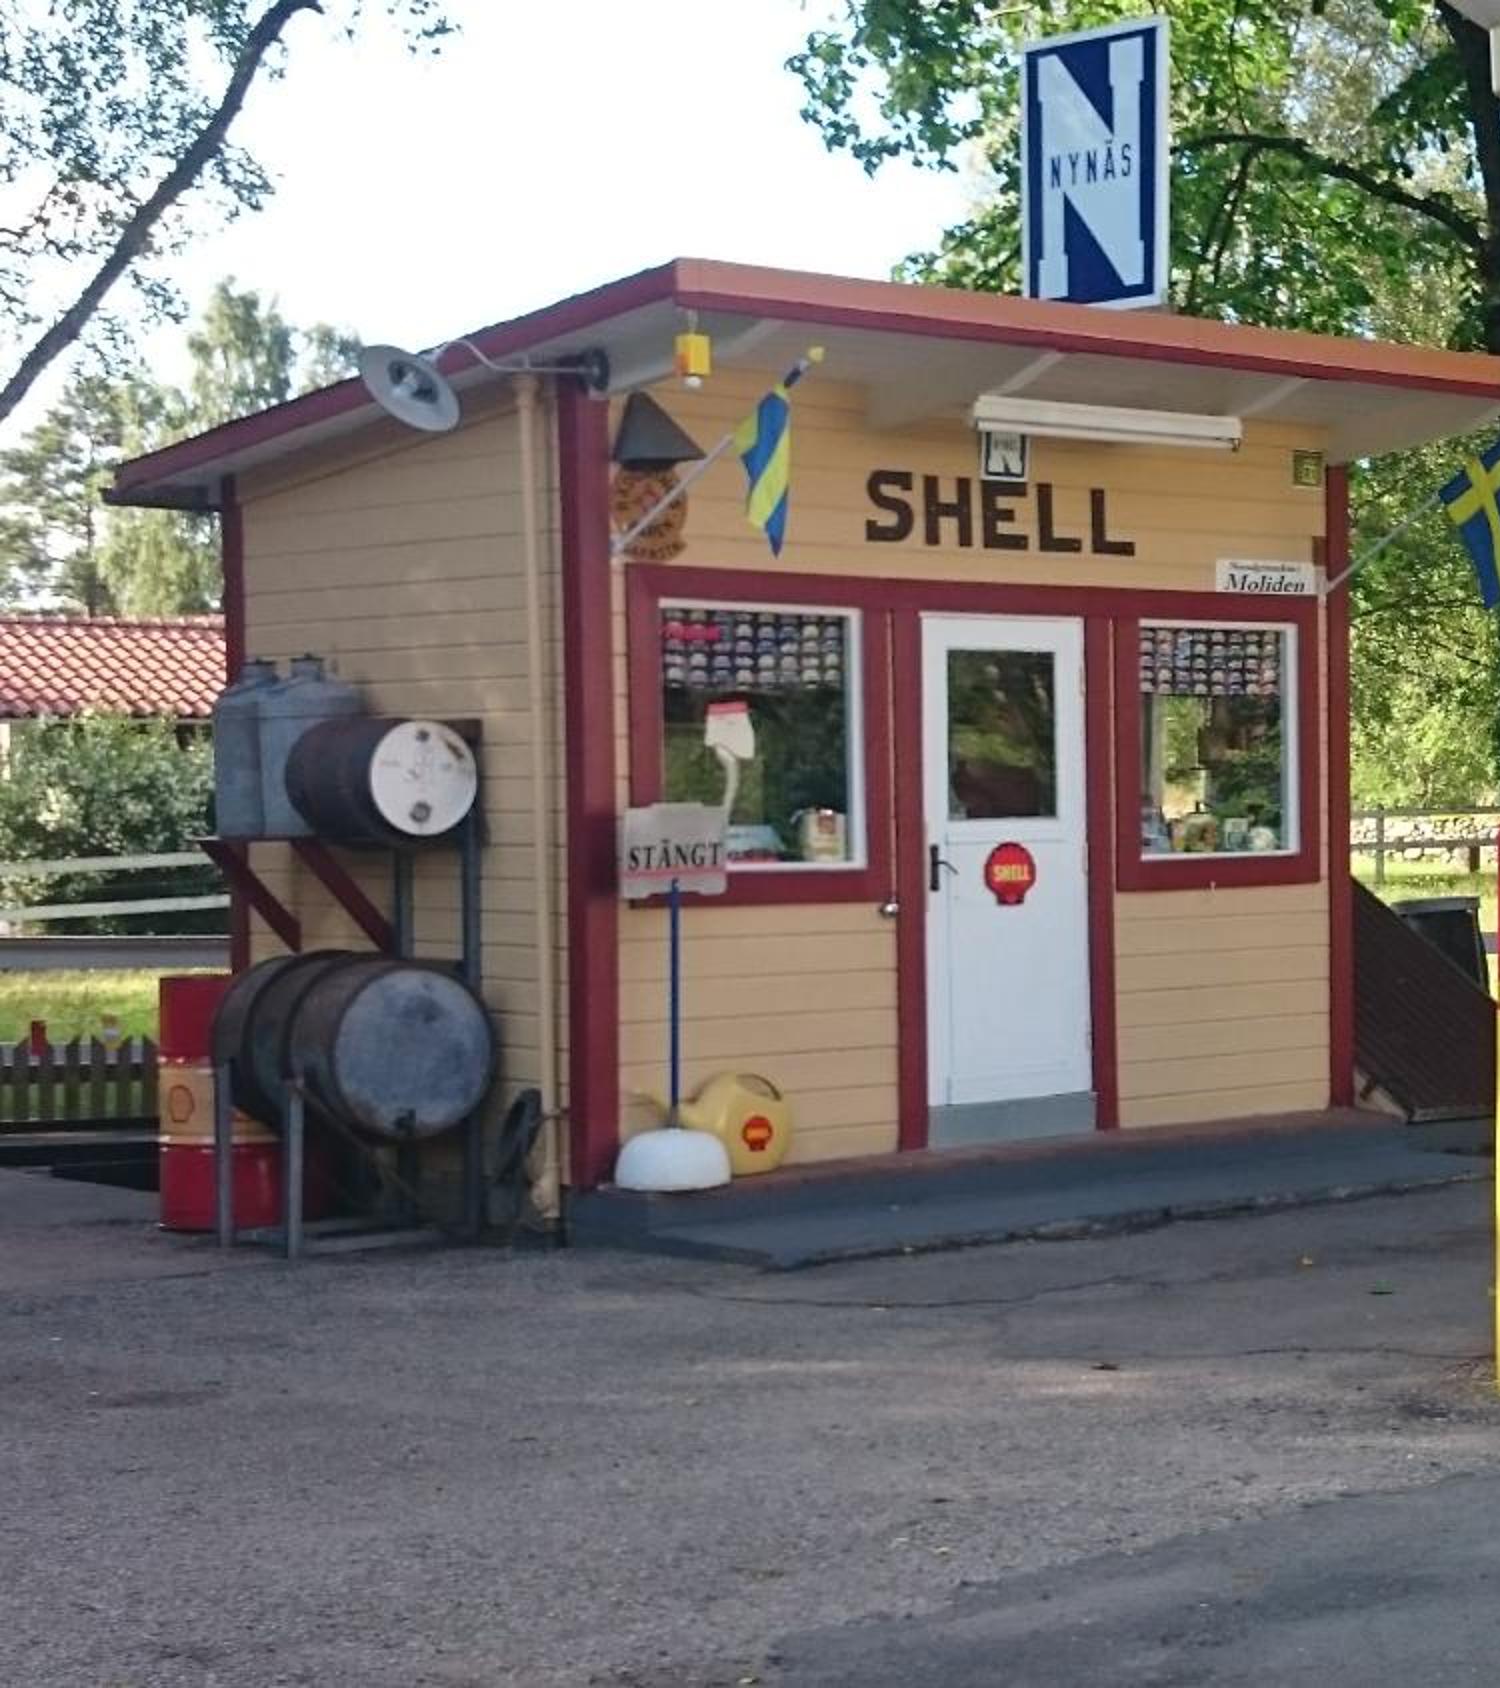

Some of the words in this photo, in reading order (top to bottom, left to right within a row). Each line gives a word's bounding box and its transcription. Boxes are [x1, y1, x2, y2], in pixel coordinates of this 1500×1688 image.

[1050, 138, 1132, 189] NYNÄS
[865, 469, 1136, 557] SHELL
[1223, 573, 1306, 593] Moliden
[628, 838, 724, 870] STÄNGT
[993, 864, 1032, 882] SHELL
